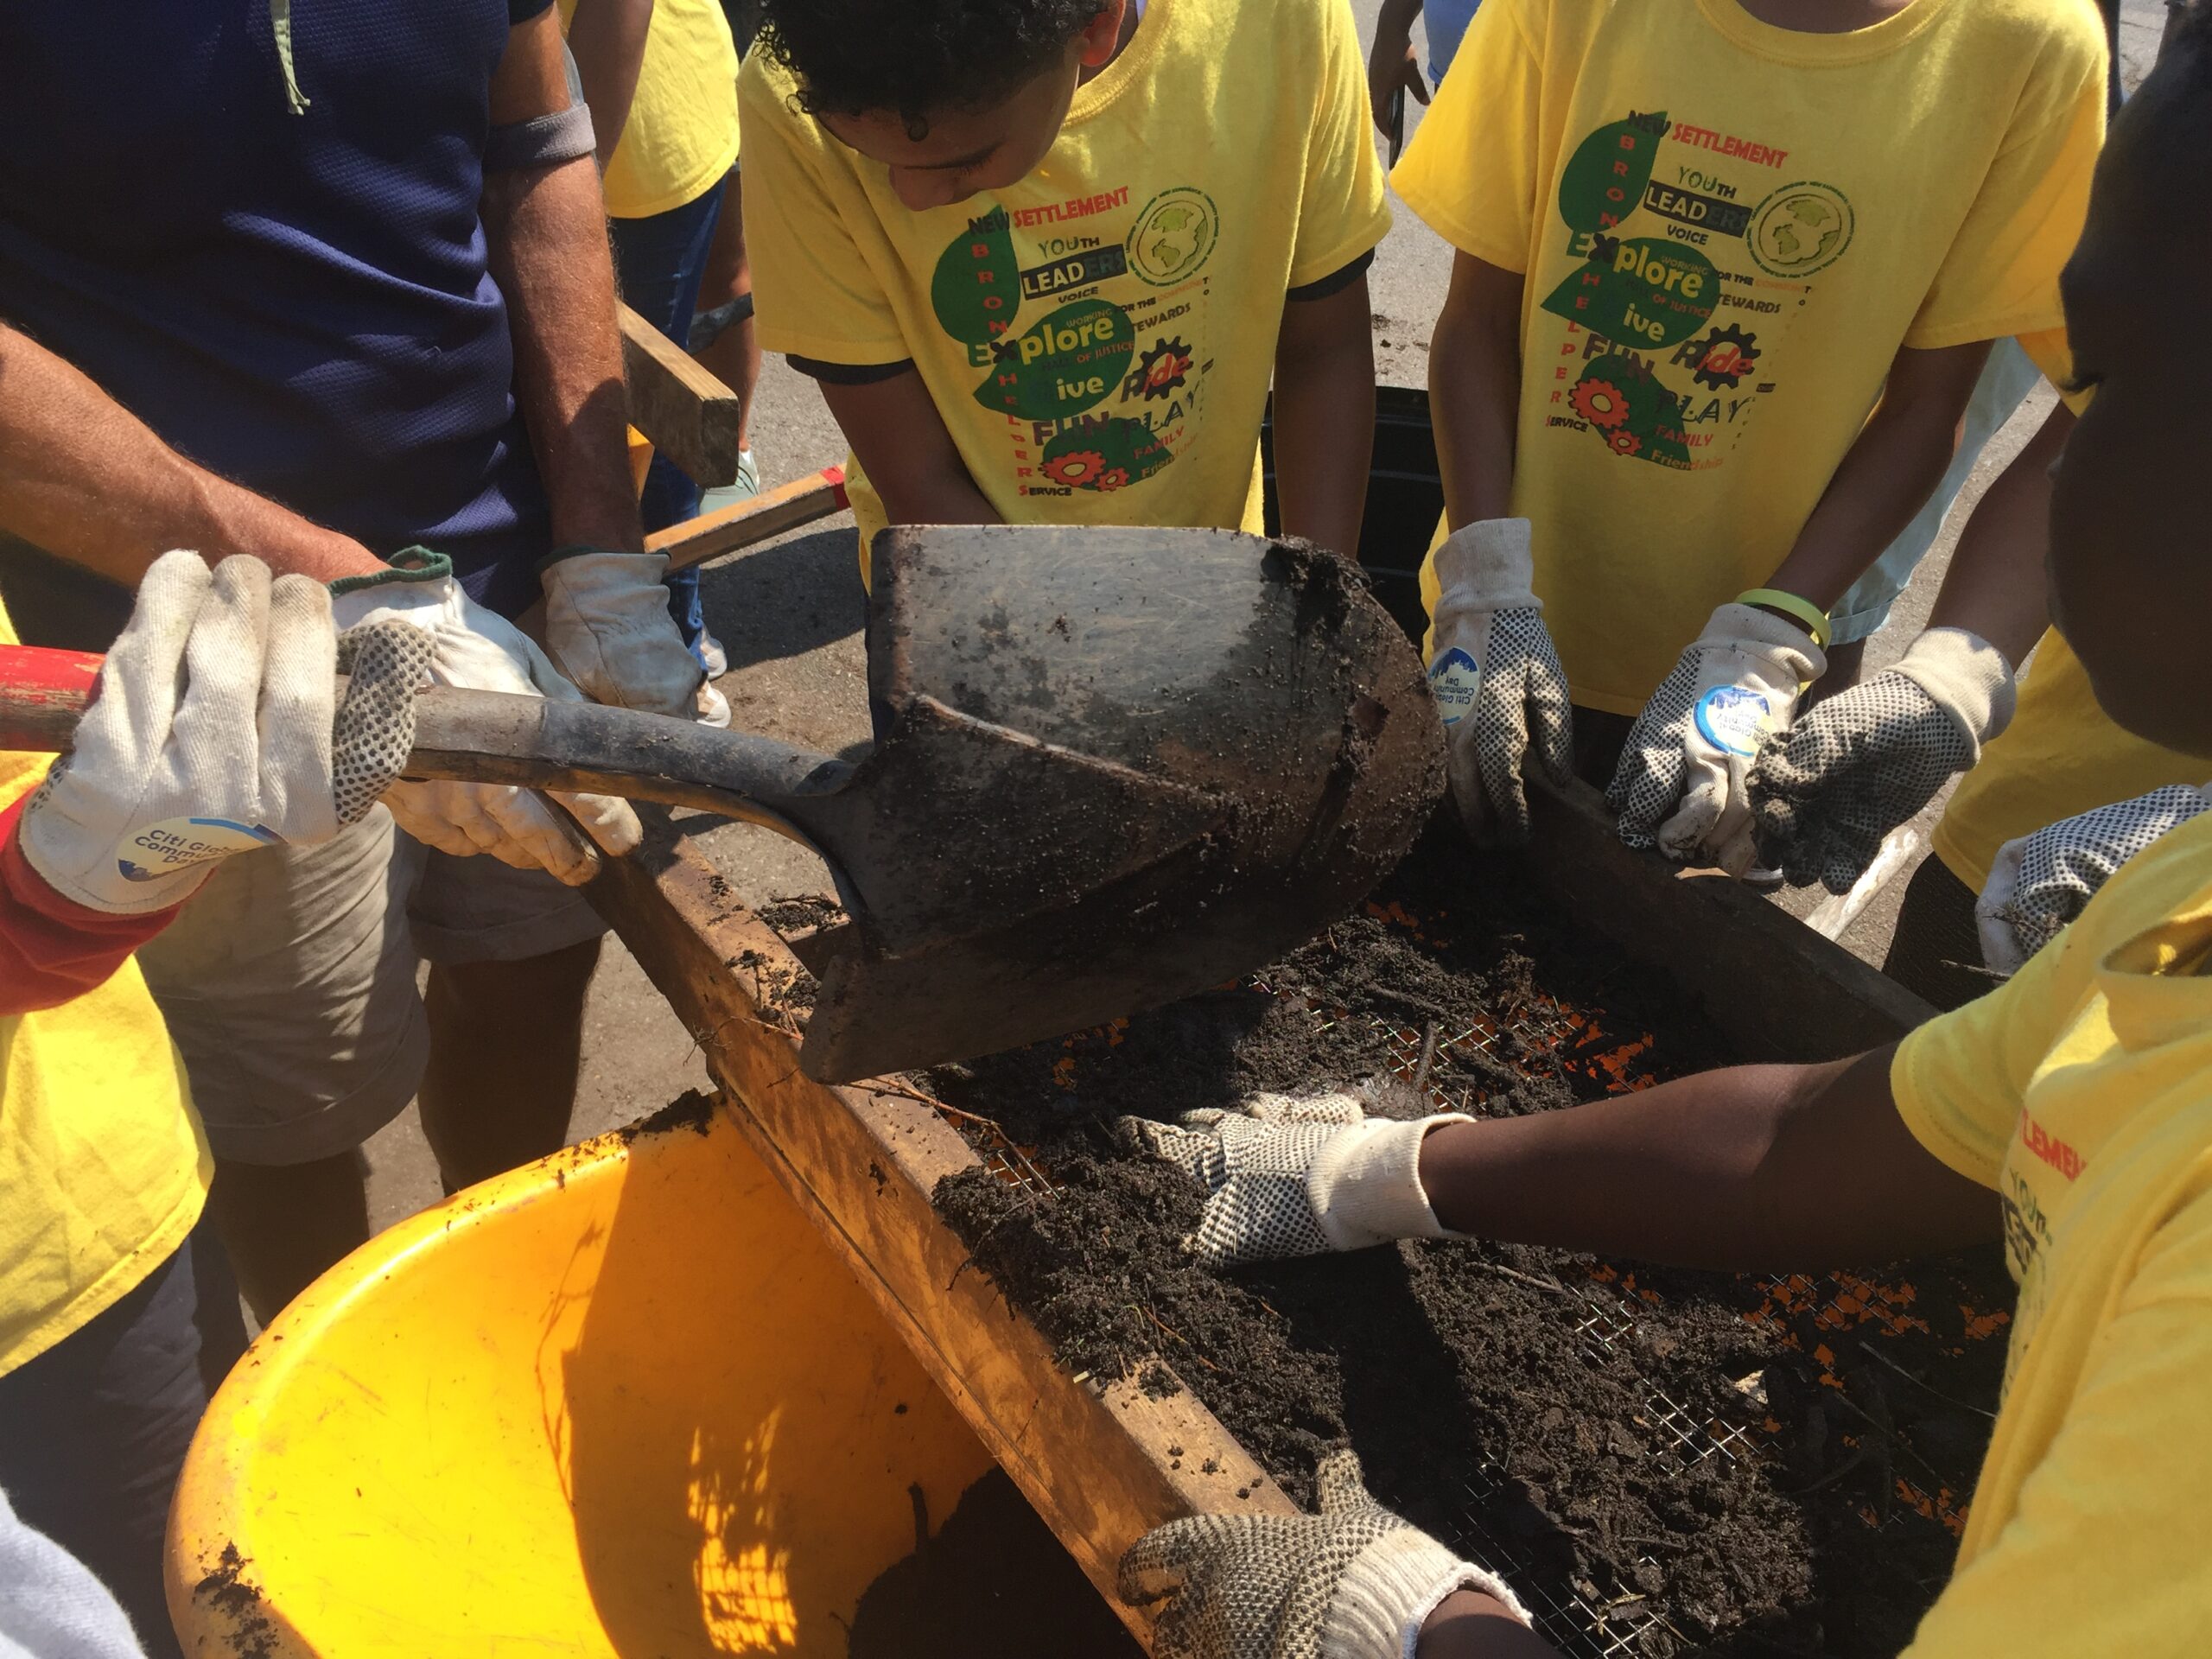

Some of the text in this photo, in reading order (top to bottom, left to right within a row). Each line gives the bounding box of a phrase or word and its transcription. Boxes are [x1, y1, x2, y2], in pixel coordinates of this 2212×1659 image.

[1626, 110, 1789, 169] NEW SETTLEMENT
[1678, 166, 1738, 200] YOUTH
[968, 185, 1128, 236] NEW SETTLEMENT
[1667, 225, 1709, 245] VOICE
[1038, 237, 1100, 259] YOUTH
[1734, 273, 1755, 287] THE
[1058, 286, 1099, 304] VOICE
[1136, 297, 1157, 310] THE
[1719, 292, 1782, 314] TEWARDS
[1131, 302, 1192, 333] TEWARDS
[1623, 302, 1666, 342] ive
[1669, 340, 1753, 378] Ride
[1056, 376, 1104, 401] ive
[1120, 353, 1190, 403] Ride
[1134, 424, 1185, 460] FAMILY
[1655, 424, 1714, 447] FAMILY
[1018, 485, 1073, 498] SERVICE
[1445, 676, 1459, 687] Day
[149, 830, 188, 848] Citi
